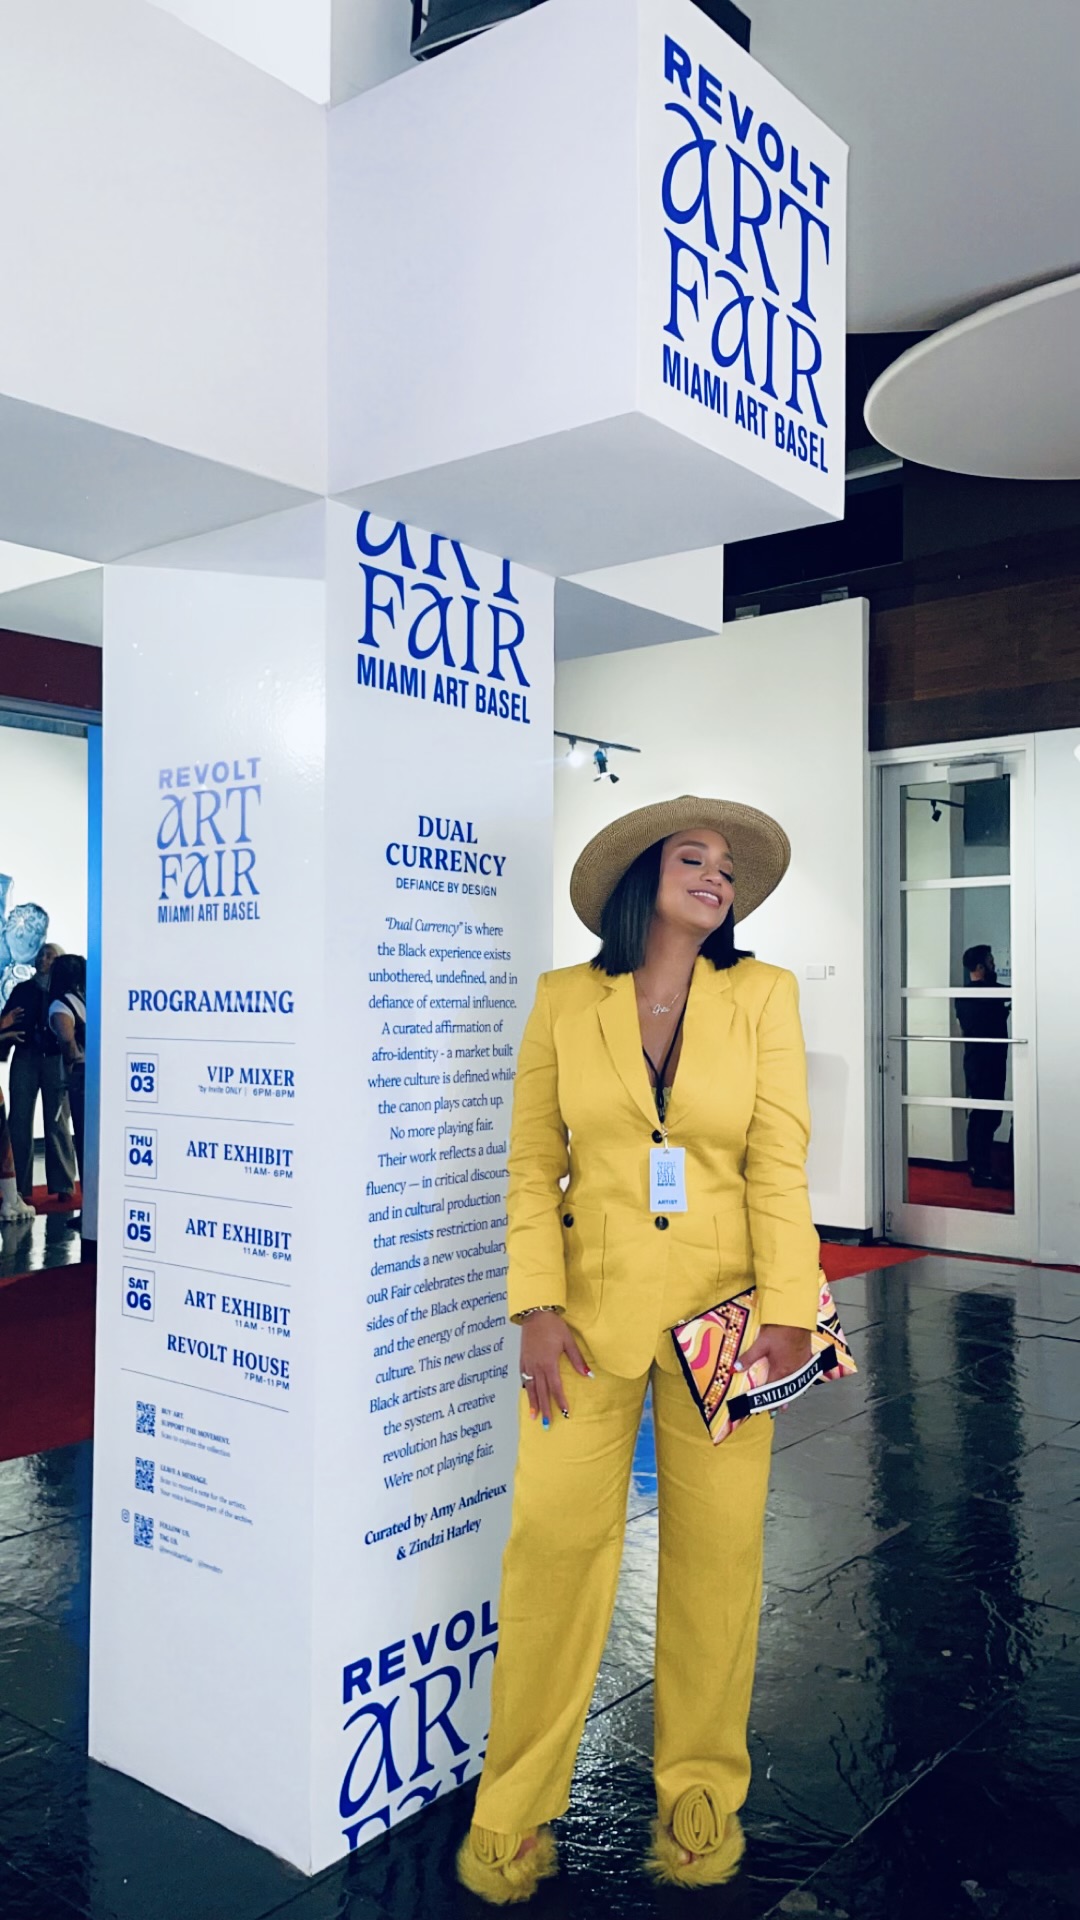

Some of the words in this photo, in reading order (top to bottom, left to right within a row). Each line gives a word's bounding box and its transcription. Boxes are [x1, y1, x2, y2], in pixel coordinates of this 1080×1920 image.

[664, 34, 830, 208] REVOLT
[663, 344, 728, 419] MIAMI
[735, 389, 769, 441] ART
[775, 409, 829, 473] BASEL
[358, 654, 426, 699] MIAMI
[433, 674, 468, 709] ART
[475, 684, 531, 724] BASEL
[159, 757, 261, 789] REVOLT
[418, 815, 478, 844] DUAL
[385, 842, 506, 876] CURRENCY
[396, 877, 445, 893] DEFIANCE
[447, 881, 459, 894] BY
[462, 882, 497, 896] DESIGN
[158, 905, 194, 923] MIAMI
[198, 904, 219, 921] ART
[224, 901, 260, 921] BASEL
[465, 922, 472, 934] is
[475, 923, 503, 936] where
[377, 943, 395, 956] the
[399, 943, 425, 957] Black
[429, 948, 482, 961] experience
[484, 949, 511, 961] exists
[369, 969, 433, 984] unbothered,
[436, 970, 487, 984] undefined,
[490, 972, 507, 984] and
[509, 973, 517, 984] in
[128, 989, 294, 1014] PROGRAMMING
[369, 995, 413, 1009] defiance
[417, 995, 428, 1008] of
[430, 996, 470, 1009] external
[473, 996, 517, 1009] influence.
[382, 1022, 390, 1034] A
[393, 1021, 432, 1034] curated
[435, 1020, 491, 1034] affirmation
[494, 1020, 503, 1032] of
[372, 1047, 438, 1062] afro-identity
[455, 1045, 490, 1058] market
[492, 1043, 513, 1056] built
[131, 1062, 155, 1073] WED
[207, 1066, 234, 1083] VIP
[239, 1068, 295, 1087] MIXER
[368, 1074, 401, 1087] where
[404, 1073, 440, 1086] culture
[443, 1072, 450, 1084] is
[453, 1069, 489, 1083] defined
[492, 1070, 516, 1081] while
[131, 1075, 154, 1092] 03
[378, 1100, 396, 1114] the
[399, 1101, 431, 1112] canon
[434, 1096, 459, 1113] plays
[462, 1094, 488, 1107] catch
[490, 1096, 504, 1109] up.
[130, 1135, 152, 1147] THU
[390, 1127, 405, 1140] No
[408, 1124, 435, 1138] more
[438, 1121, 474, 1139] playing
[476, 1118, 493, 1131] fair.
[129, 1148, 153, 1166] 04
[187, 1141, 218, 1159] ART
[224, 1144, 293, 1167] EXHIBIT
[378, 1153, 407, 1168] Their
[410, 1149, 437, 1163] work
[439, 1146, 476, 1160] reflects
[486, 1141, 507, 1155] dual
[274, 1170, 292, 1178] 6PM
[366, 1181, 407, 1195] fluency
[422, 1176, 432, 1188] in
[435, 1170, 468, 1187] critical
[470, 1168, 510, 1182] discours
[130, 1210, 150, 1222] FRI
[369, 1207, 389, 1222] and
[392, 1204, 402, 1219] in
[405, 1198, 444, 1217] cultural
[447, 1193, 500, 1214] production
[127, 1223, 151, 1242] 05
[186, 1218, 217, 1238] ART
[223, 1224, 292, 1250] EXHIBIT
[374, 1234, 396, 1249] that
[399, 1229, 434, 1244] resists
[436, 1220, 488, 1238] restriction
[491, 1214, 508, 1228] and
[272, 1251, 292, 1261] 6PM
[371, 1255, 420, 1277] demands
[432, 1251, 454, 1264] new
[456, 1241, 506, 1259] vocabulary
[128, 1277, 149, 1290] SAT
[367, 1289, 388, 1304] ouR
[391, 1283, 412, 1299] Fair
[414, 1274, 464, 1296] celebrates
[467, 1268, 483, 1282] the
[127, 1291, 151, 1310] 06
[184, 1289, 216, 1310] ART
[222, 1296, 290, 1325] EXHIBIT
[366, 1316, 394, 1332] sides
[397, 1310, 409, 1325] of
[411, 1307, 428, 1322] the
[431, 1300, 458, 1317] Black
[373, 1341, 394, 1357] and
[397, 1338, 415, 1351] the
[417, 1331, 452, 1347] energy
[454, 1322, 465, 1336] of
[467, 1315, 506, 1333] modern
[167, 1334, 227, 1363] REVOLT
[233, 1349, 290, 1379] HOUSE
[375, 1366, 416, 1384] culture.
[419, 1356, 441, 1372] This
[444, 1351, 465, 1365] new
[468, 1344, 492, 1359] class
[493, 1337, 504, 1352] of
[370, 1393, 400, 1413] Black
[402, 1385, 437, 1404] artists
[440, 1379, 455, 1392] are
[457, 1364, 508, 1388] disrupting
[754, 1382, 796, 1406] EMILIO
[384, 1420, 402, 1435] the
[404, 1409, 445, 1431] system.
[448, 1403, 455, 1415] A
[457, 1392, 496, 1411] creative
[383, 1437, 437, 1463] revolution
[440, 1428, 457, 1444] has
[460, 1420, 492, 1438] begun.
[416, 1464, 434, 1479] not
[437, 1452, 474, 1475] playing
[476, 1443, 494, 1458] fair.
[365, 1516, 411, 1545] Curated
[414, 1513, 428, 1529] by
[430, 1501, 456, 1521] Amy
[458, 1484, 507, 1509] Andrieux
[397, 1546, 406, 1560] &
[409, 1532, 444, 1556] Zindzi
[447, 1517, 481, 1541] Harley
[343, 1600, 498, 1704] REVOL
